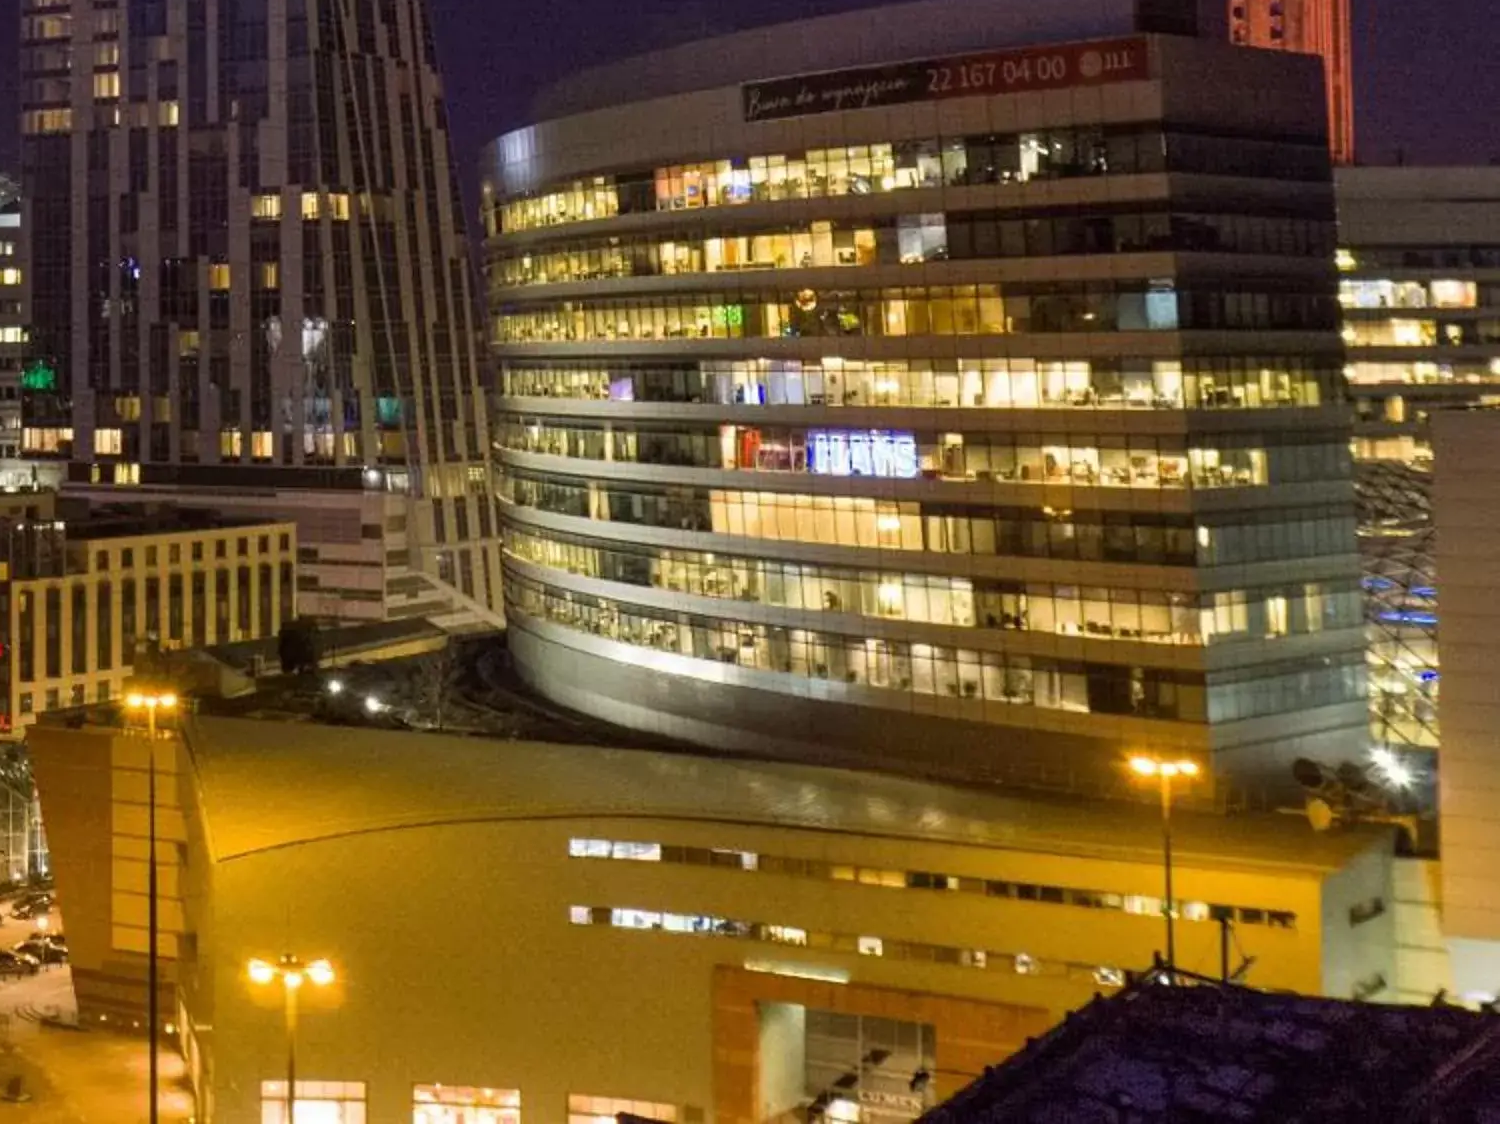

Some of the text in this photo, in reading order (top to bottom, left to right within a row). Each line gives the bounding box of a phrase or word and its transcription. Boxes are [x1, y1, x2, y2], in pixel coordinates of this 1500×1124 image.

[926, 68, 952, 93] 22
[960, 63, 996, 88] 167
[1003, 58, 1030, 84] 04
[1037, 55, 1067, 80] 00
